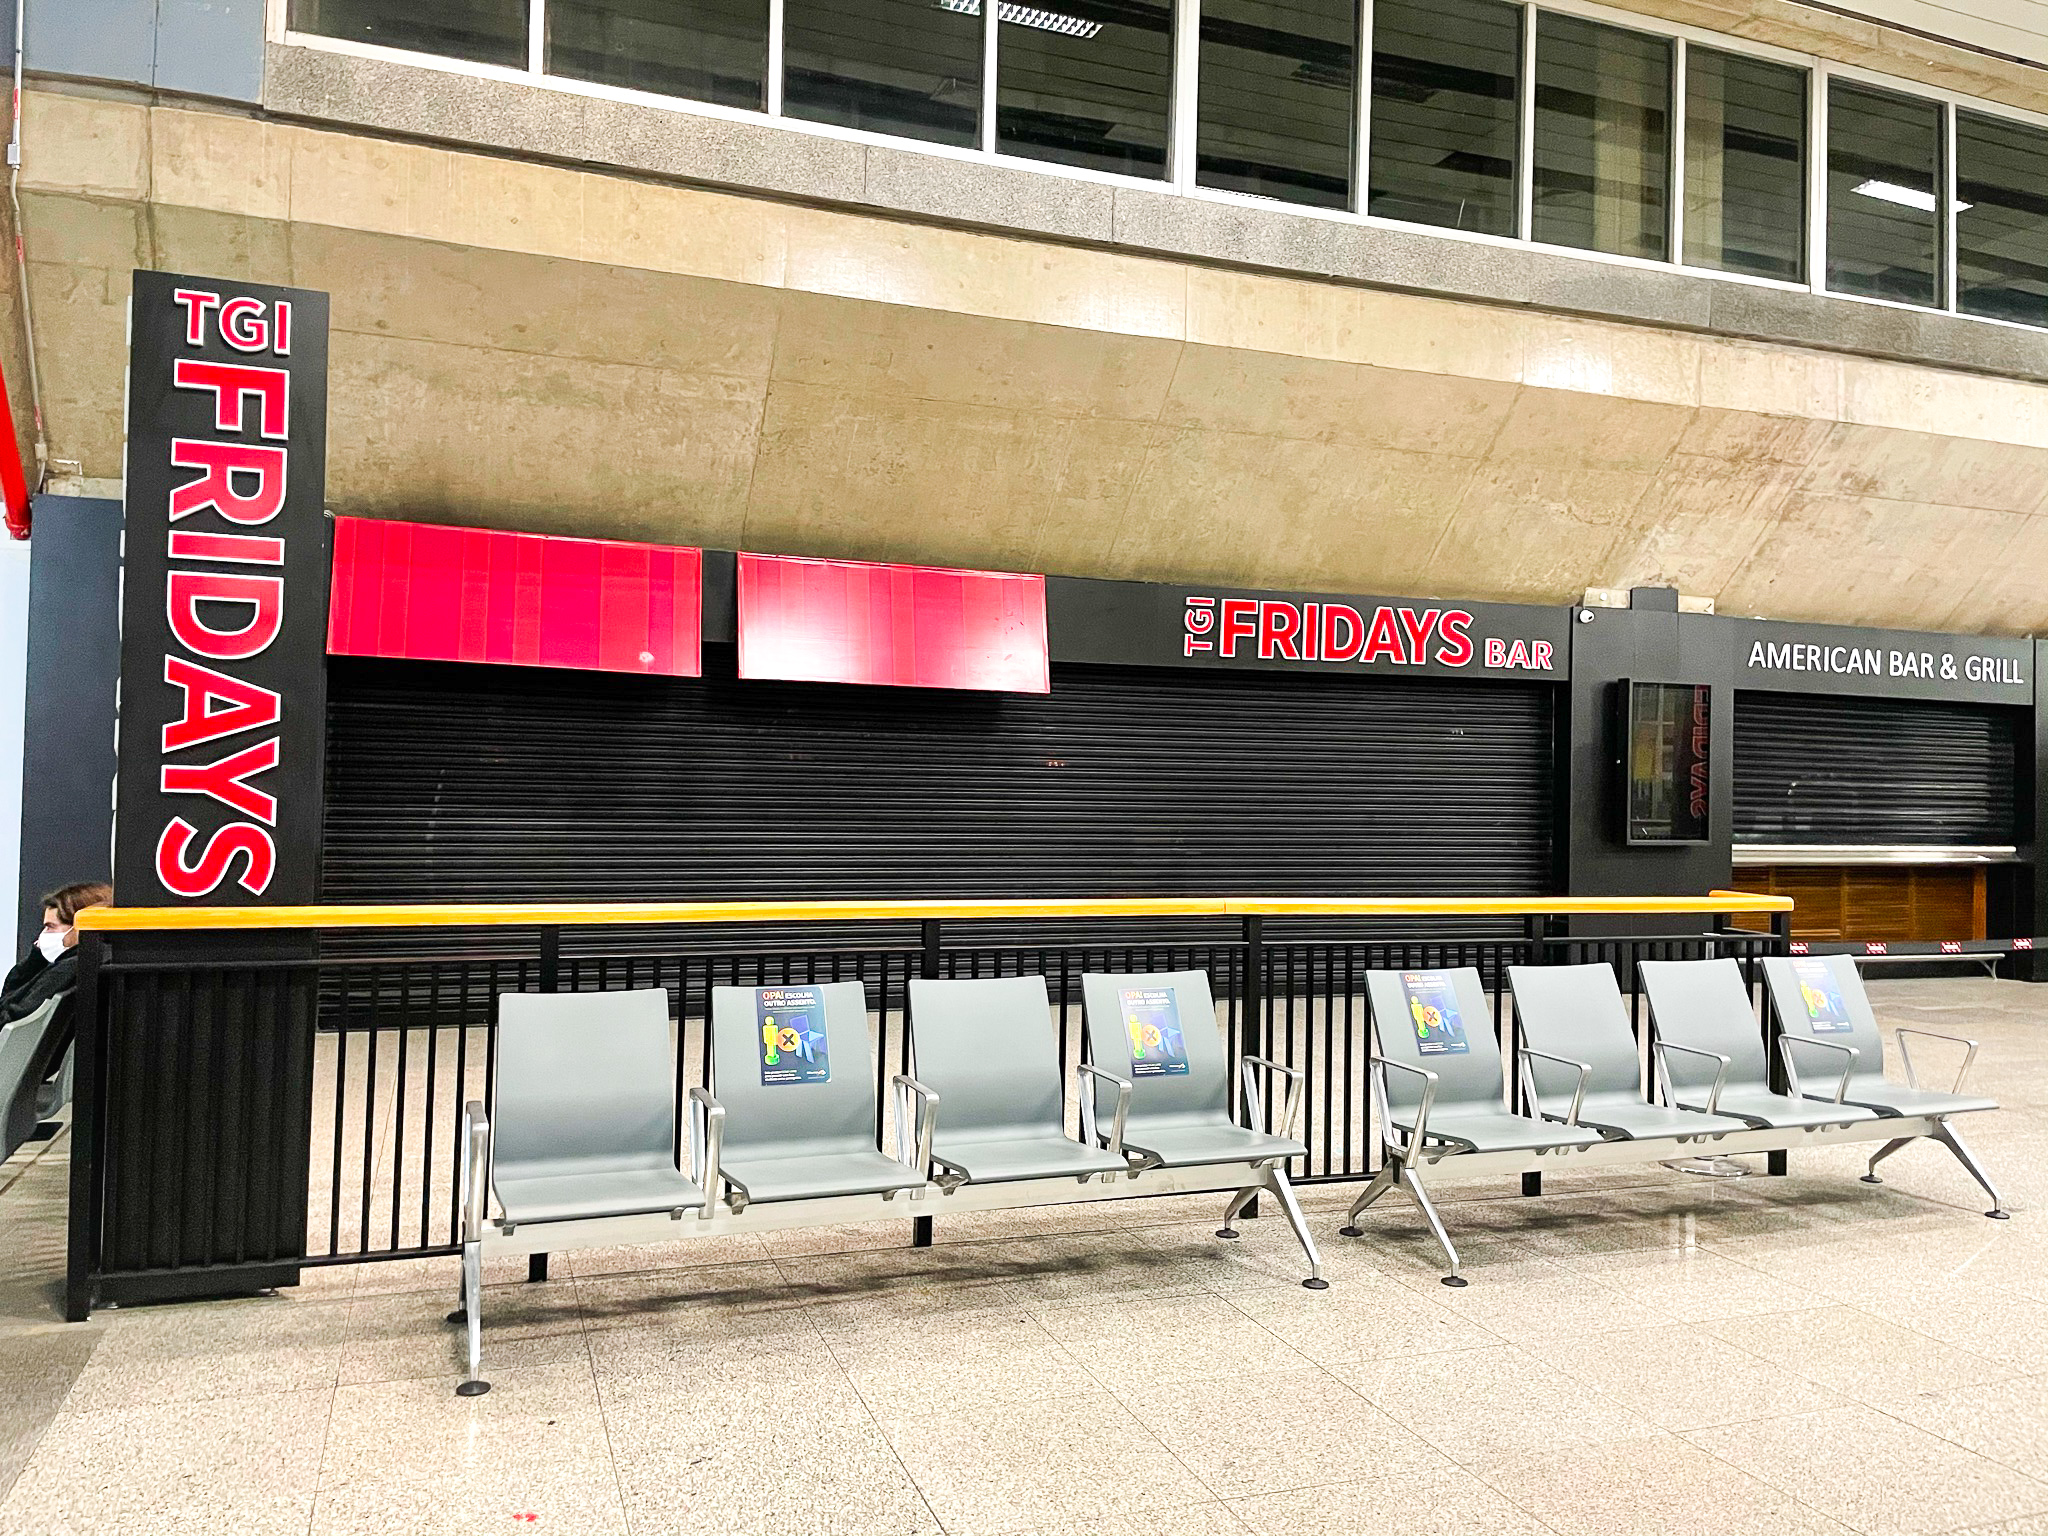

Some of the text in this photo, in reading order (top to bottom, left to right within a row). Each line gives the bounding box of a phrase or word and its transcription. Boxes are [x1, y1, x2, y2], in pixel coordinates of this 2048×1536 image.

[173, 288, 292, 357] TGI
[155, 358, 290, 897] FRIDAYS
[1184, 596, 1554, 671] TGI FRIDAYS BAR
[1747, 640, 2024, 684] AMERICAN BAR & GRILL
[762, 990, 784, 1000] OPA!
